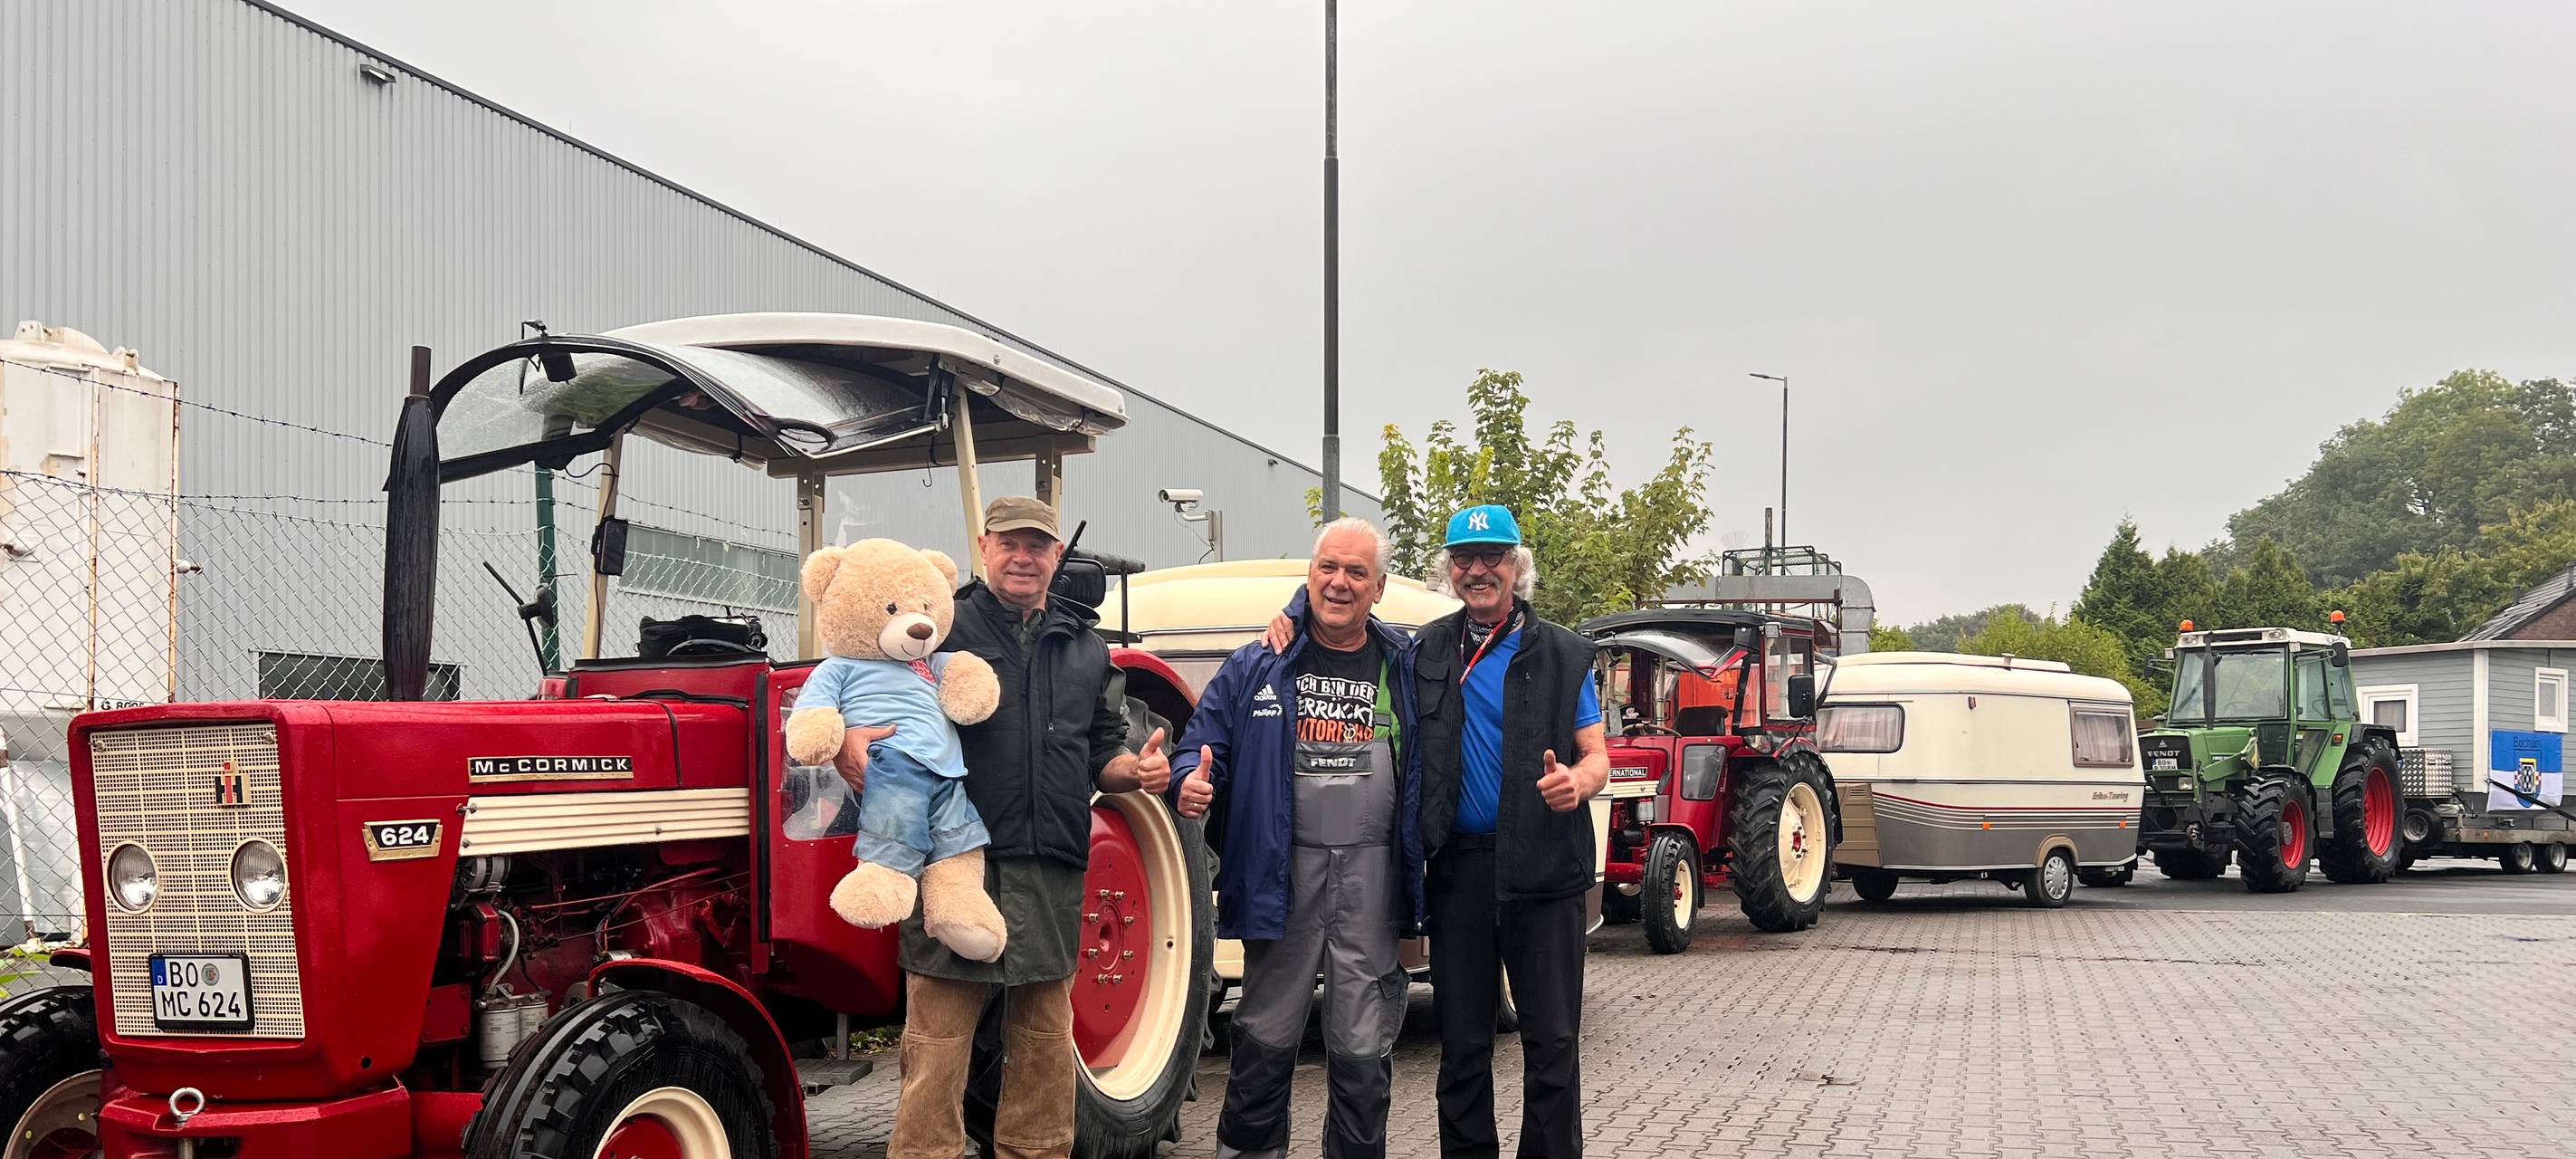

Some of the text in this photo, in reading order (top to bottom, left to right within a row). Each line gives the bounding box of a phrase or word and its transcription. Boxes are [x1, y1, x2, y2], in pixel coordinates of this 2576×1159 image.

[1468, 512, 1489, 531] NY
[1321, 680, 1346, 696] BIN
[1350, 684, 1375, 703] DER
[1311, 758, 1356, 767] FENDT
[2147, 750, 2180, 758] FENDT
[380, 825, 429, 846] 624
[169, 962, 198, 987] BO
[161, 991, 241, 1018] MC 624
